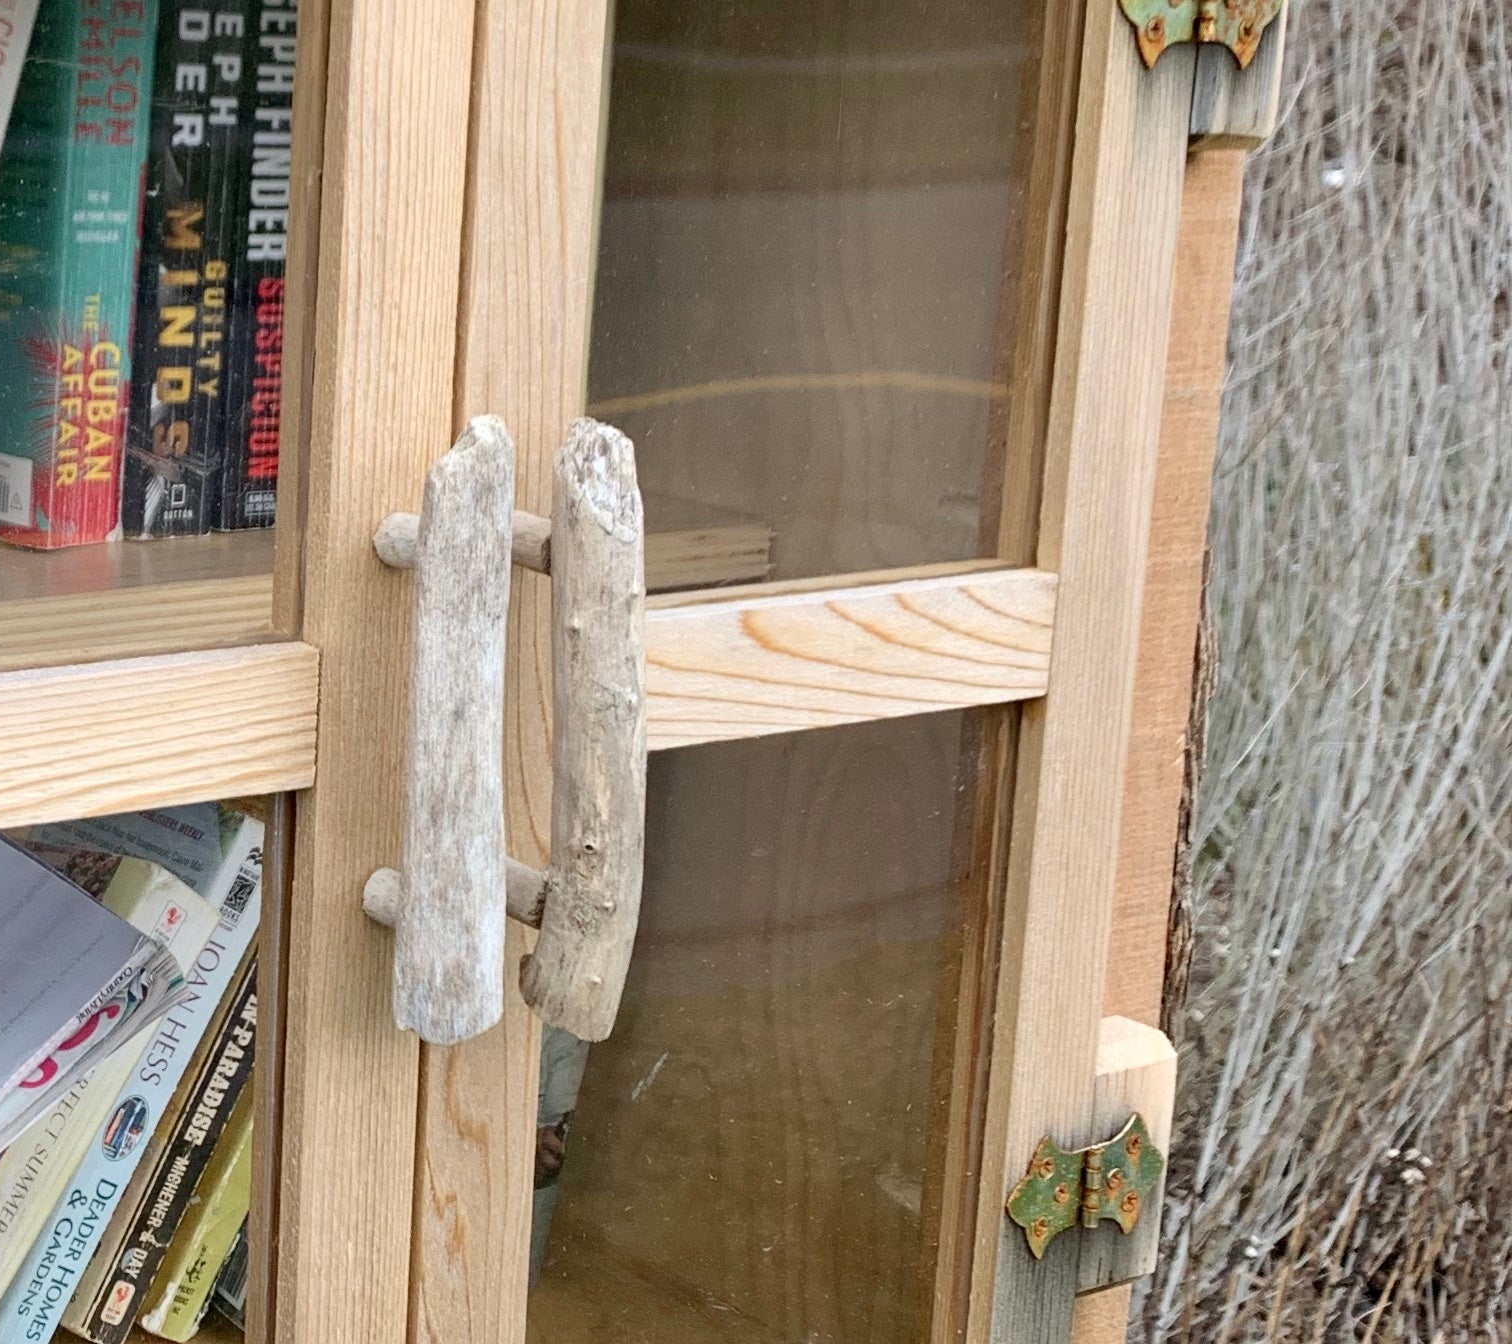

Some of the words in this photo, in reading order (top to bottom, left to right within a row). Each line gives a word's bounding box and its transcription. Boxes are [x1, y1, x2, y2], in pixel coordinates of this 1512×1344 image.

[247, 108, 293, 262] FINDER
[82, 292, 103, 334] THE
[152, 199, 205, 458] MINDS
[196, 258, 228, 400] GUILTY
[56, 343, 84, 488] AFFAIR
[83, 341, 122, 483] CUBAN
[247, 276, 285, 481] SUSPICION
[178, 940, 227, 1015] JOAN
[139, 1017, 187, 1087] HESS
[183, 1024, 255, 1147] PARADISE
[67, 1188, 89, 1210] &
[71, 1177, 119, 1264] DEADER
[145, 1154, 189, 1229] MICHENER
[17, 1216, 73, 1317] GARDENS
[126, 1247, 149, 1280] DAY
[139, 1228, 156, 1247] &
[25, 1264, 75, 1342] HOMES
